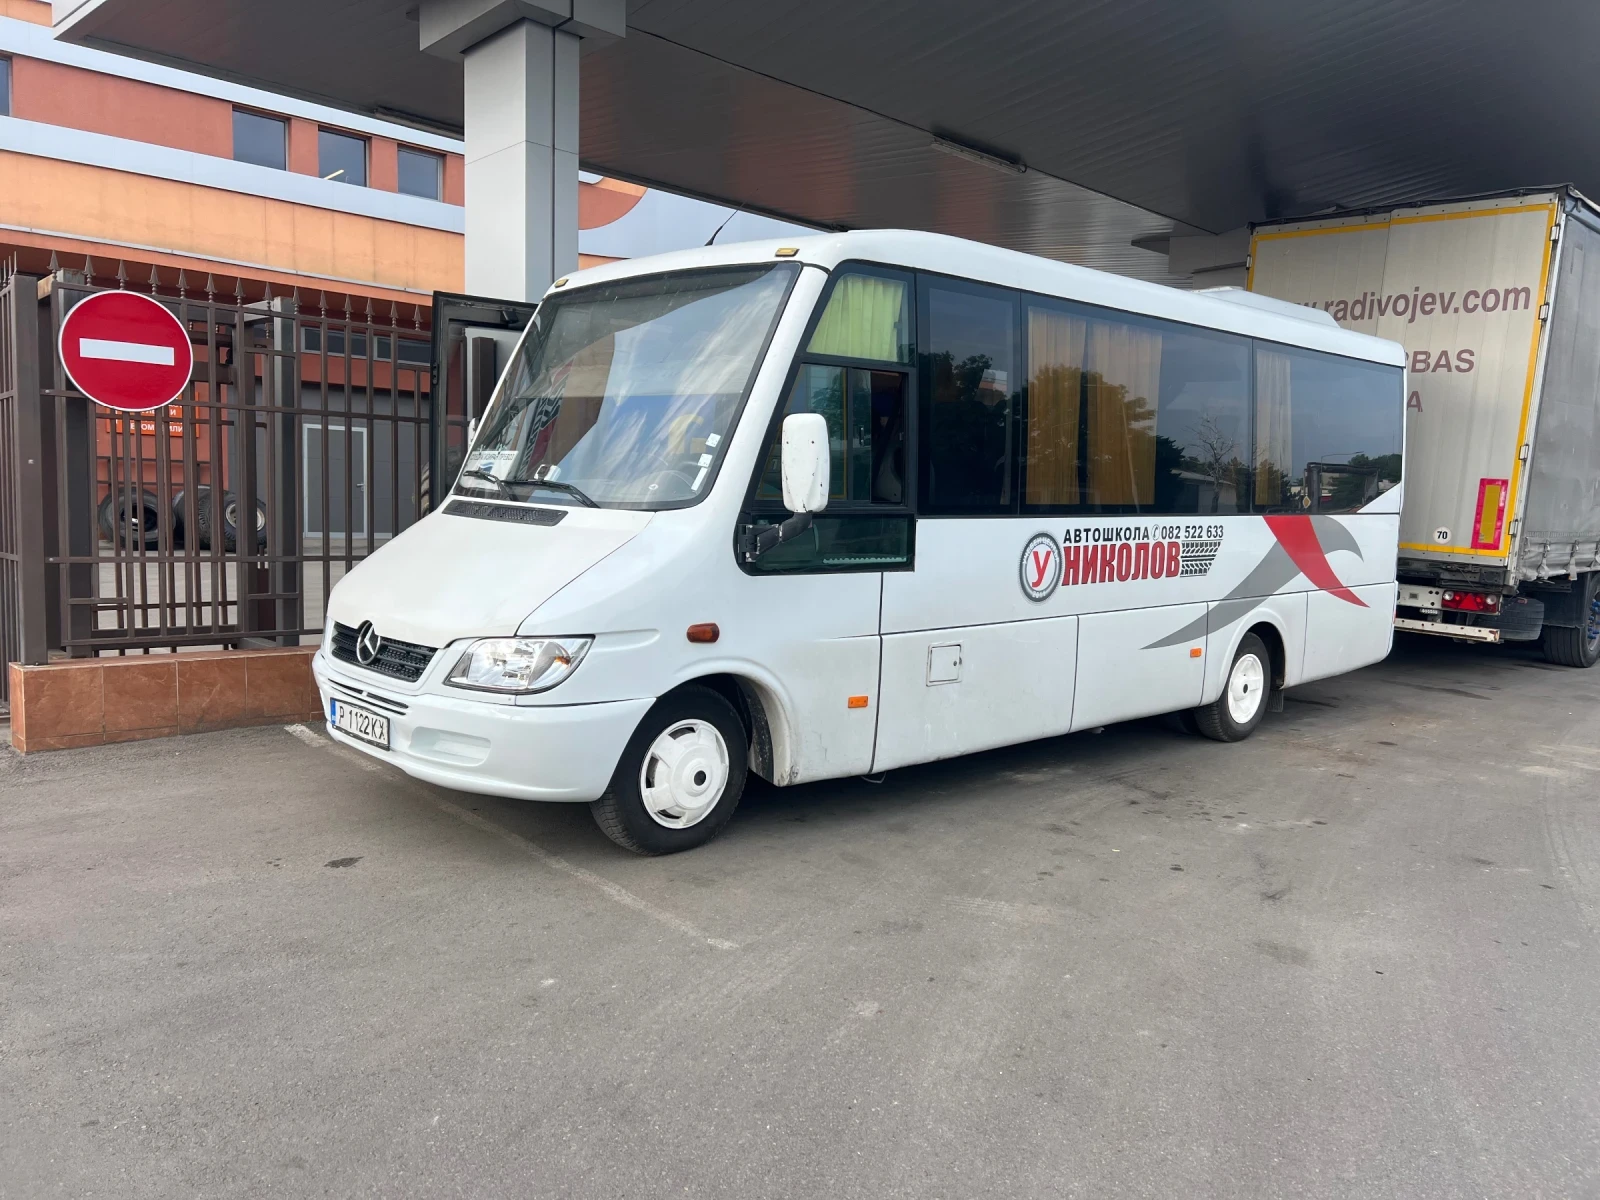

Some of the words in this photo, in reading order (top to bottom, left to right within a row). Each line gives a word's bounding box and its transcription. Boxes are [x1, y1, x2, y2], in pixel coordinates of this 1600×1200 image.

[1405, 349, 1475, 373] BAS
[1063, 526, 1150, 544] АВТОШКОЛА
[1161, 526, 1181, 540] 082
[1184, 525, 1204, 539] 522
[1206, 525, 1224, 539] 633
[1437, 530, 1448, 540] 70
[1061, 541, 1181, 587] НИКОЛОВ
